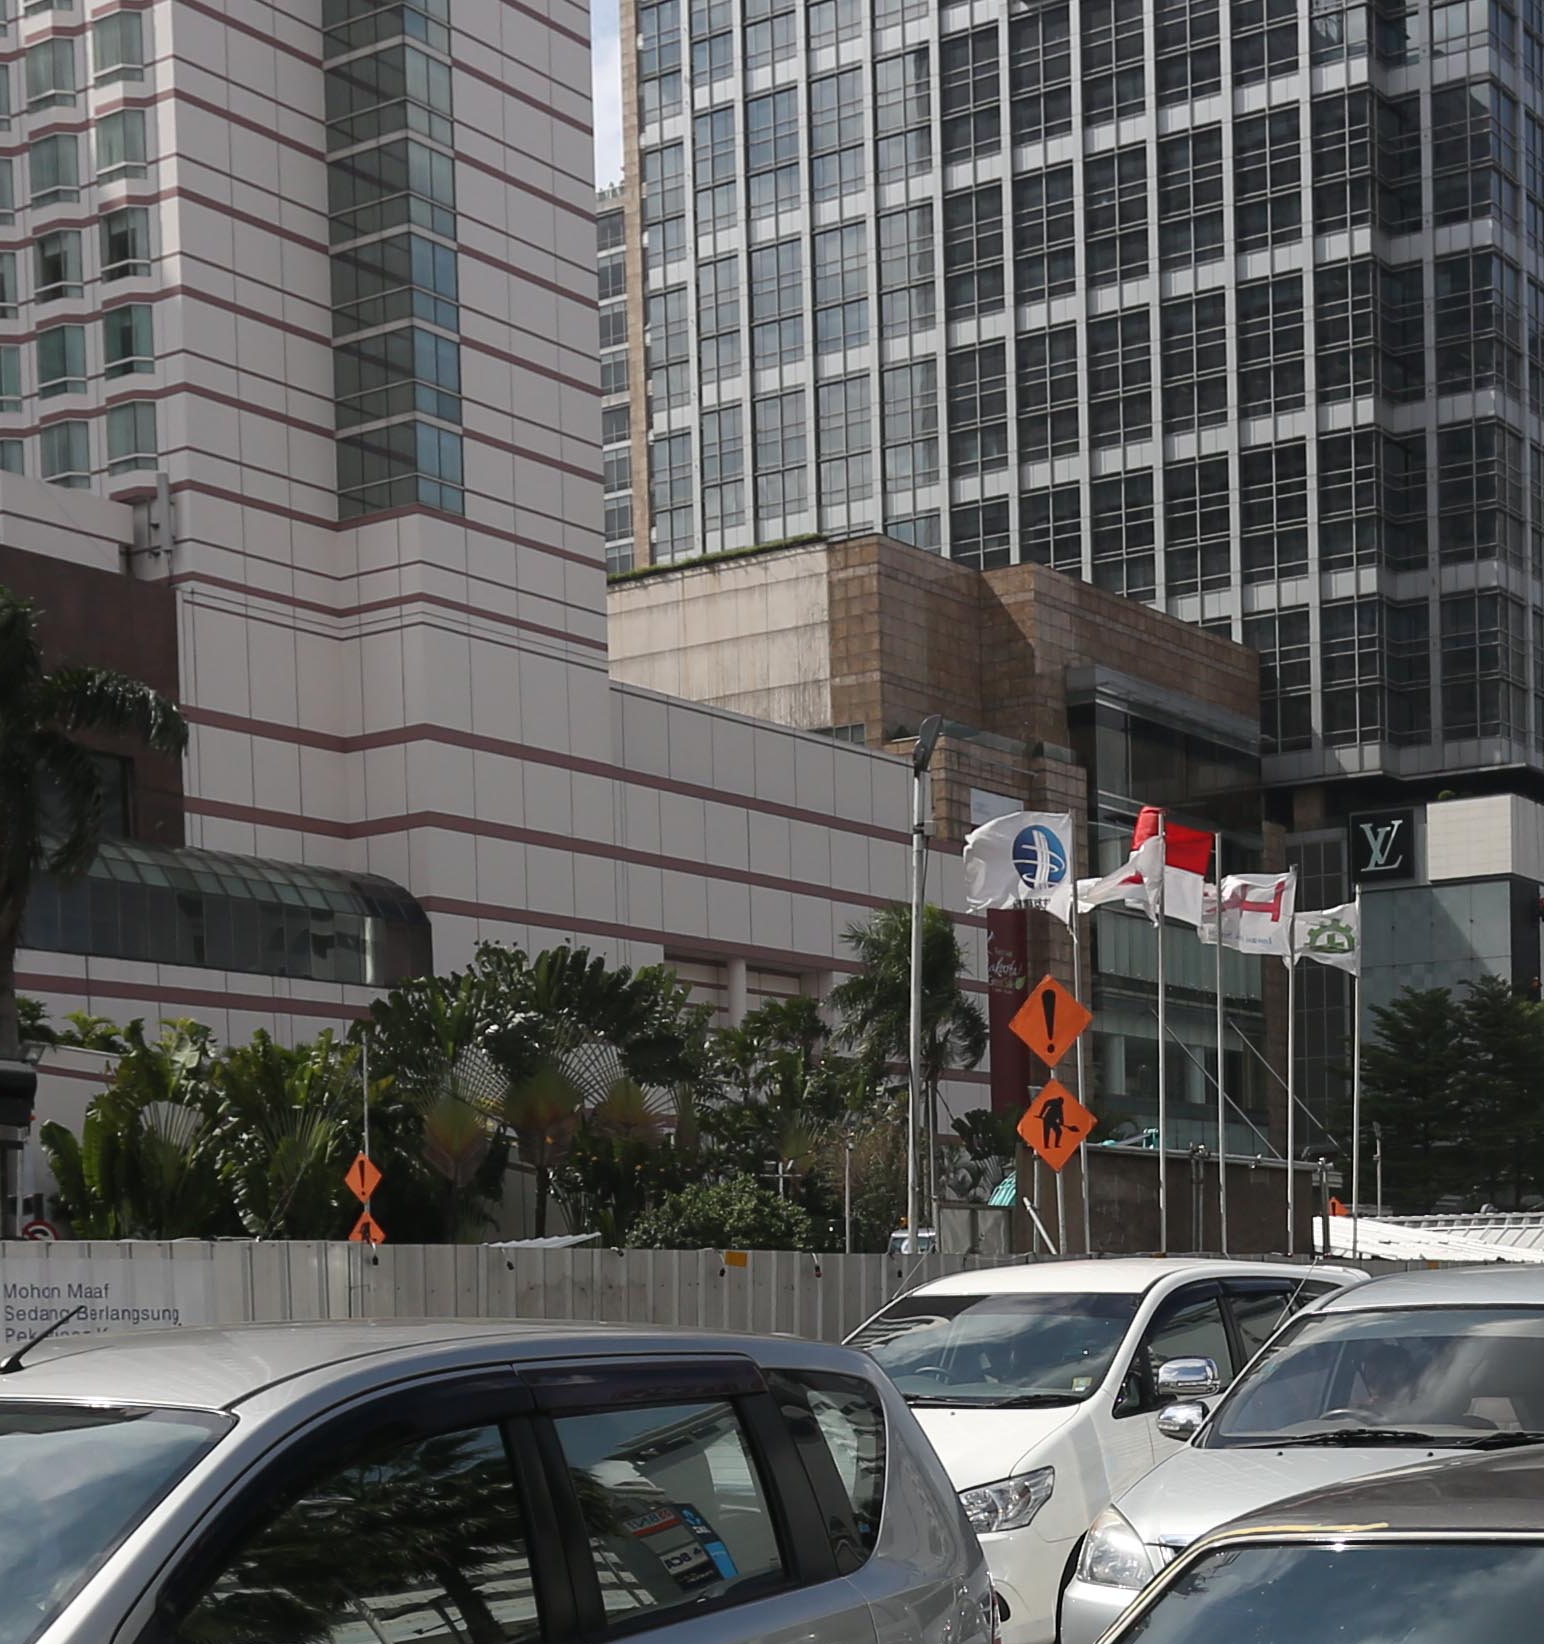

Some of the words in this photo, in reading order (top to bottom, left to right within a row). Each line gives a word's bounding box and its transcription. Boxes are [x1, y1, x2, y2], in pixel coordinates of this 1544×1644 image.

[3, 1283, 61, 1299] Mohon
[67, 1283, 110, 1299] Maaf
[76, 1305, 180, 1326] Berlangsung
